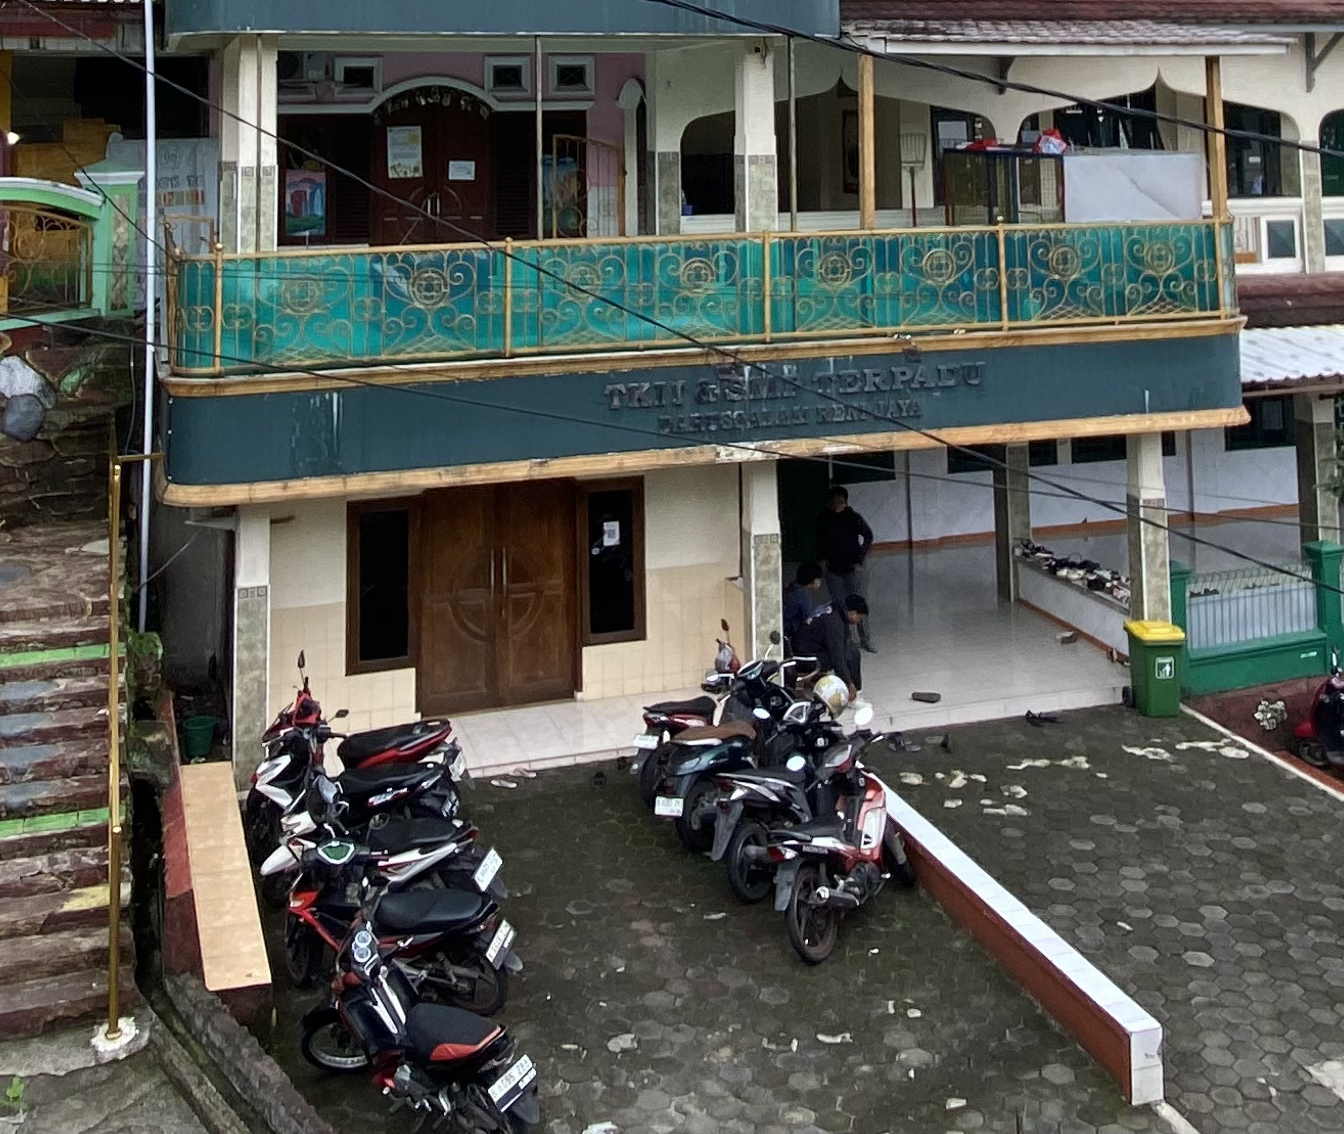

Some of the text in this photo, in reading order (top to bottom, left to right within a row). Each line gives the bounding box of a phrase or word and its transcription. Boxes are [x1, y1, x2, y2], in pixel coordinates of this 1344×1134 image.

[812, 361, 988, 395] TERPADU
[873, 397, 924, 420] JAYA
[803, 844, 828, 855] HONDA
